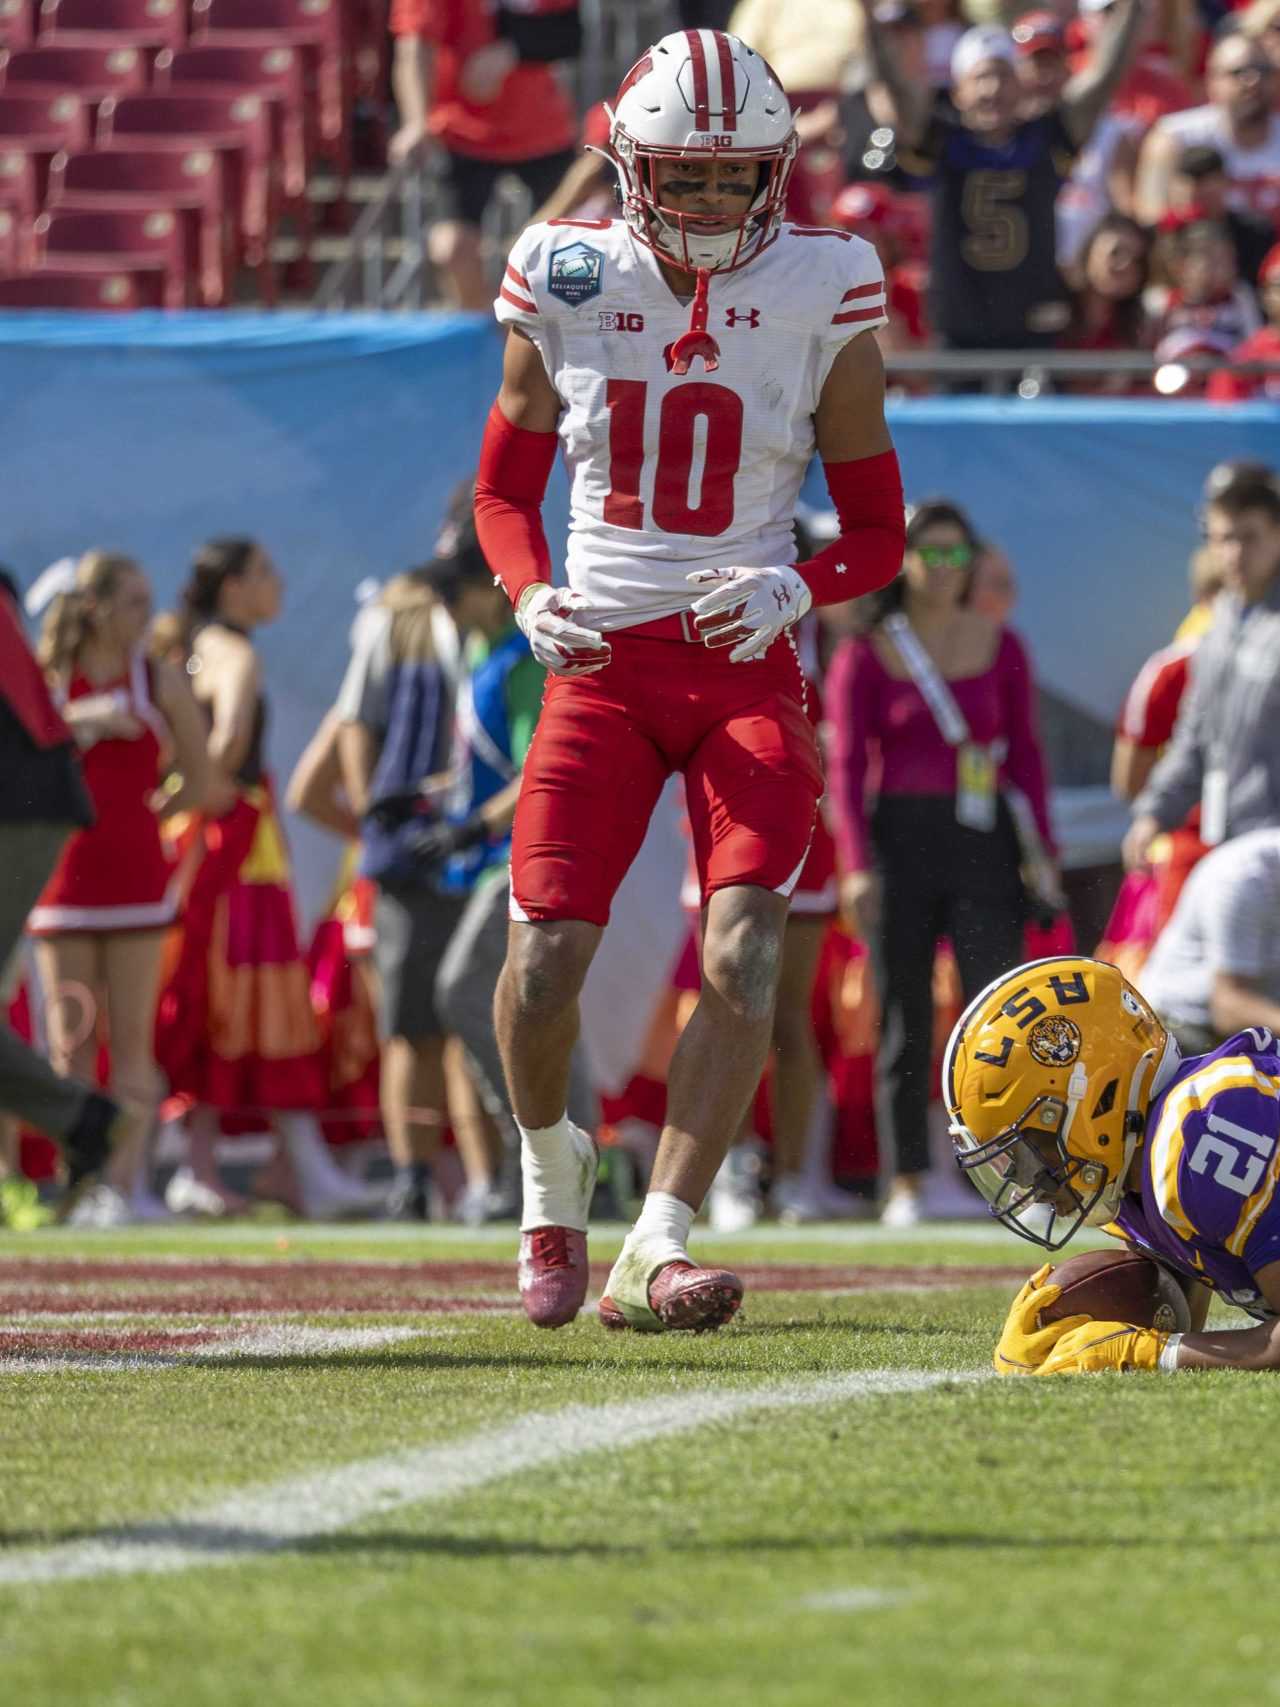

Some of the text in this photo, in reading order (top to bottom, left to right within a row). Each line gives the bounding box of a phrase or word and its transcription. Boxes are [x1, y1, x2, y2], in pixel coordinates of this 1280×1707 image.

[960, 170, 1030, 272] 5
[603, 378, 744, 537] 10
[1188, 1114, 1275, 1197] 21
